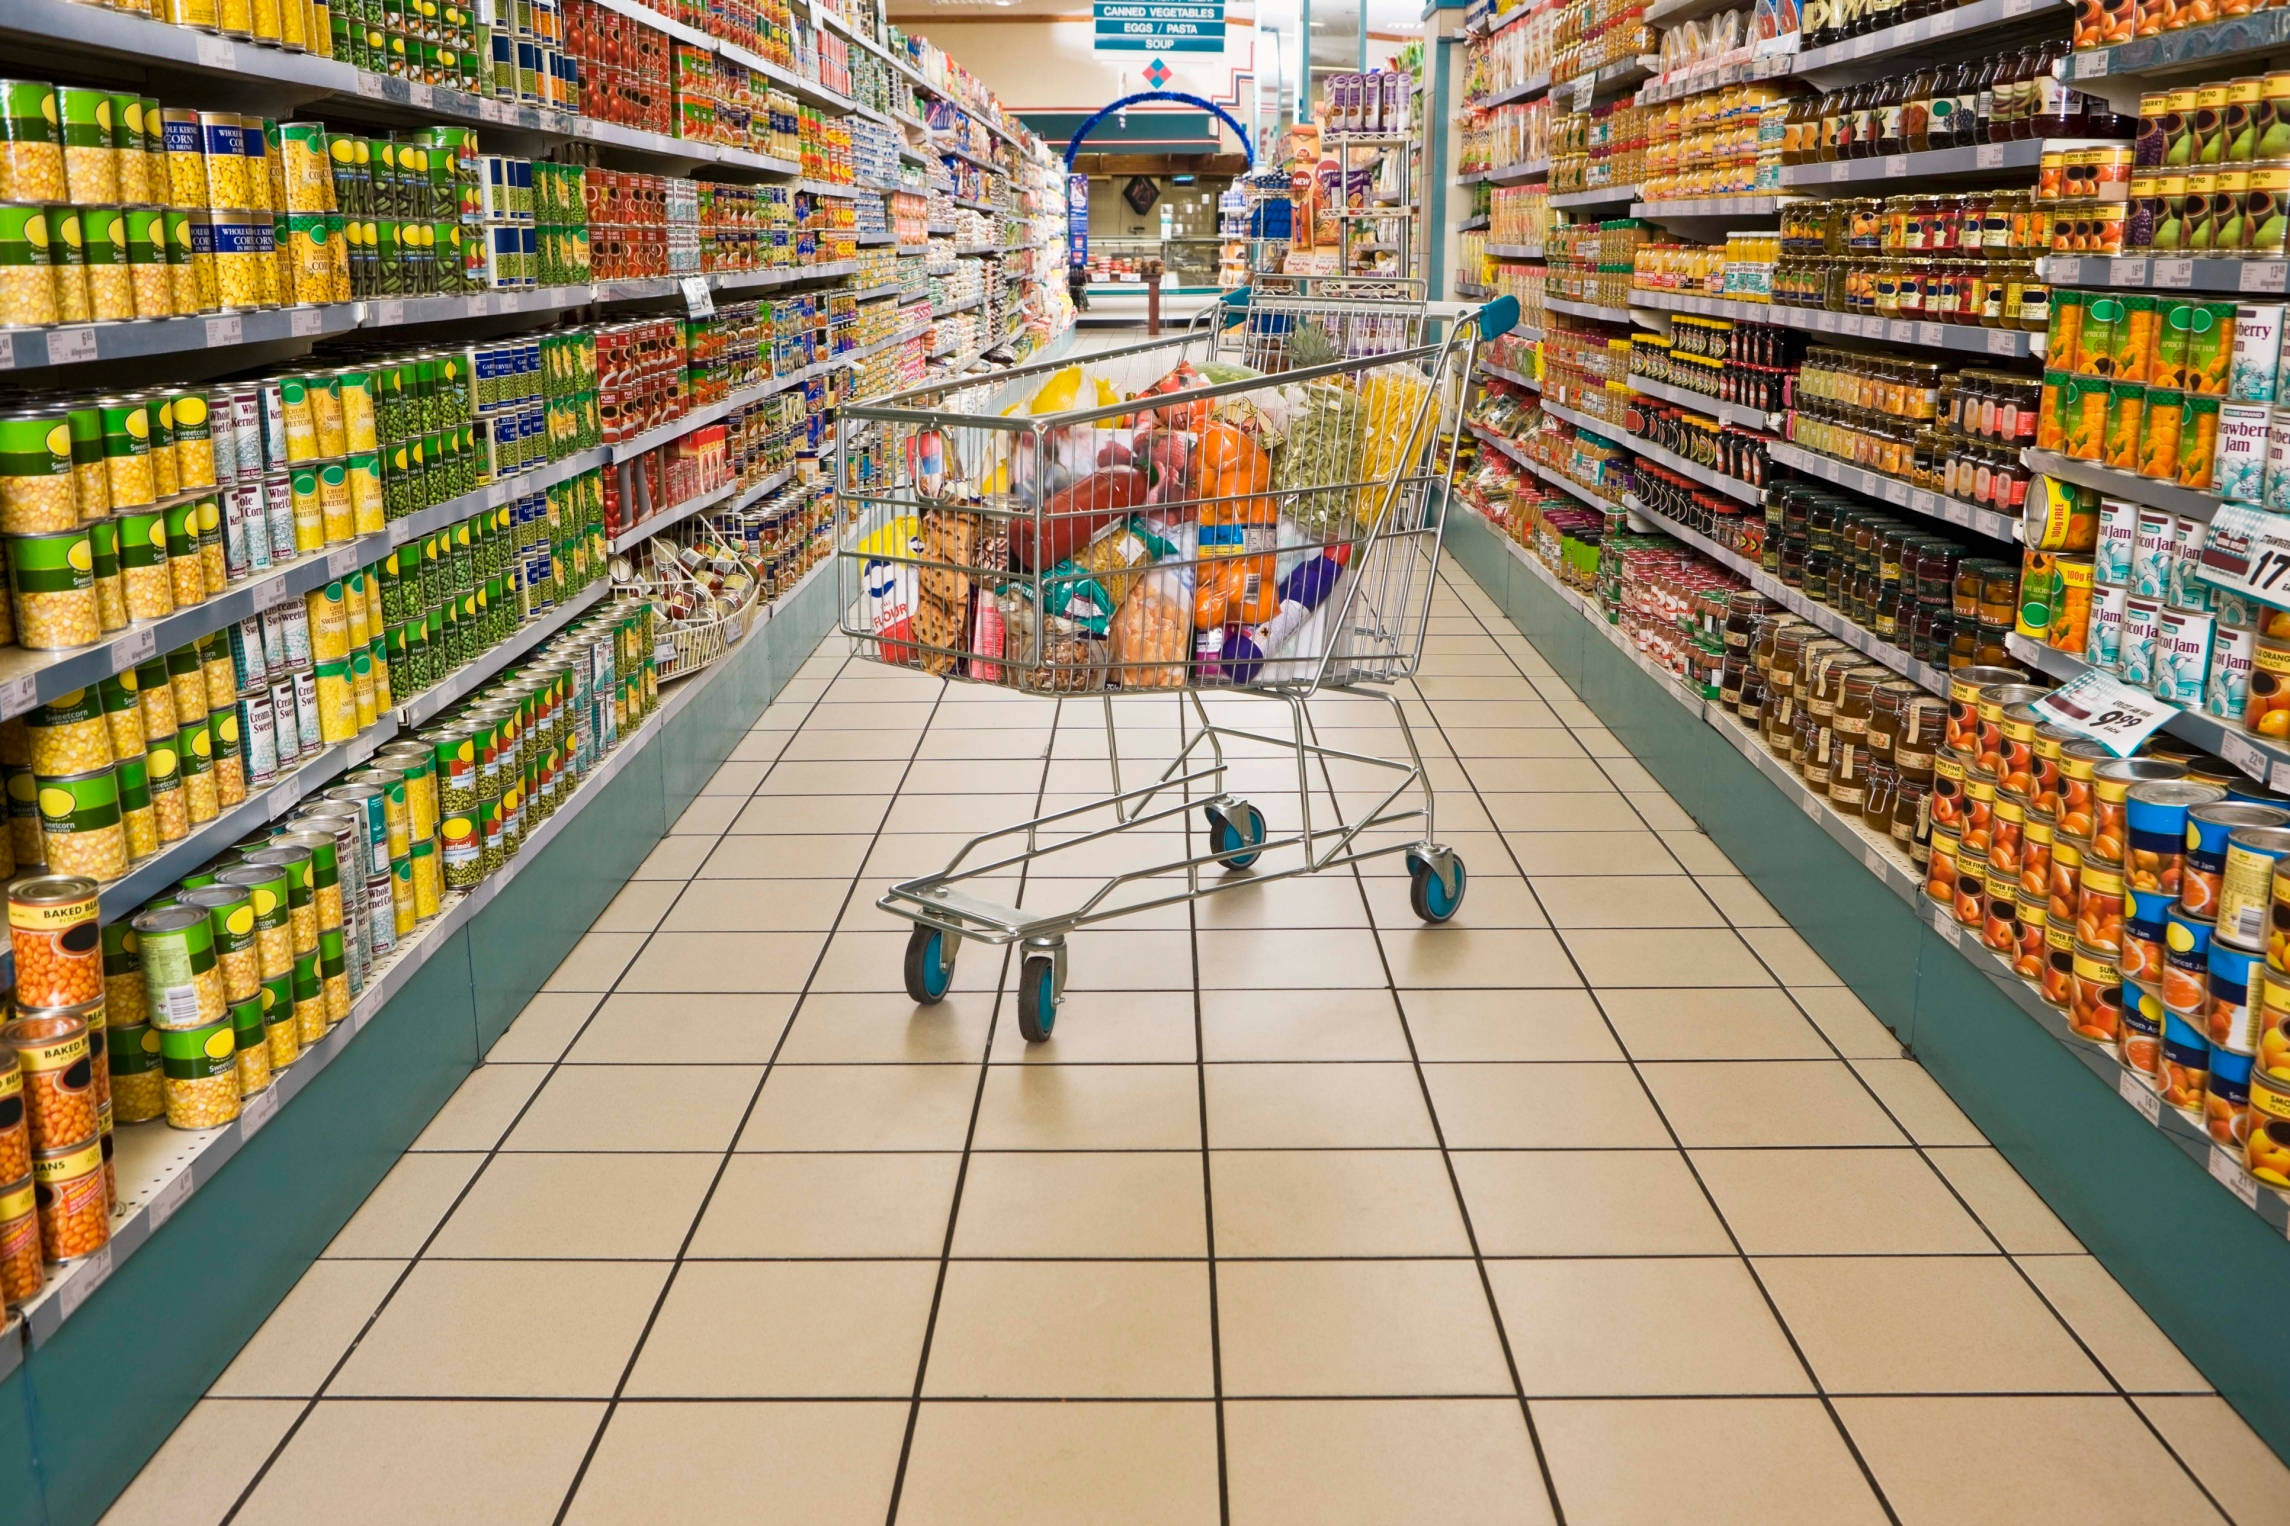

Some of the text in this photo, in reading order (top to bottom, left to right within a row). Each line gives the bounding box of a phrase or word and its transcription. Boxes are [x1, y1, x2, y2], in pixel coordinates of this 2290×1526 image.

[1103, 6, 1215, 18] CANNED VEGETABLES
[1124, 22, 1153, 32] EGGS
[1166, 24, 1197, 34] PASTA
[1145, 39, 1174, 49] SOUP
[164, 134, 193, 144] CORN
[229, 138, 244, 147] CO
[255, 236, 273, 246] ORN
[30, 252, 49, 260] Swee
[210, 409, 230, 421] Whole
[242, 404, 257, 415] Who
[270, 409, 282, 420] Ker
[130, 444, 150, 452] Sweet
[2224, 436, 2250, 453] Jam
[51, 462, 71, 471] Sweet
[240, 495, 253, 507] ole
[230, 514, 241, 526] Ker
[2051, 503, 2064, 539] 100g FREE
[2109, 524, 2131, 540] Jam
[73, 577, 93, 586] Sweet
[2067, 569, 2085, 582] 100g
[873, 603, 908, 628] FLOUR
[2099, 609, 2121, 623] Jam
[2173, 638, 2200, 654] Jam
[2225, 653, 2252, 670] Jam
[2103, 726, 2121, 735] EACH
[1948, 762, 1961, 772] FINE
[43, 822, 75, 831] weetcorn
[337, 839, 350, 852] Who
[1959, 857, 1987, 871] SUPER FINE
[2200, 863, 2216, 871] Jam
[1990, 880, 2006, 891] SUPER
[368, 887, 389, 899] Whole
[368, 898, 384, 909] rnel
[43, 905, 82, 919] BAKED
[2050, 930, 2068, 942] SUPER
[2136, 929, 2150, 938] Jam
[88, 1007, 104, 1022] BEA
[2125, 1016, 2146, 1030] Smooth
[44, 1042, 81, 1059] BAKED
